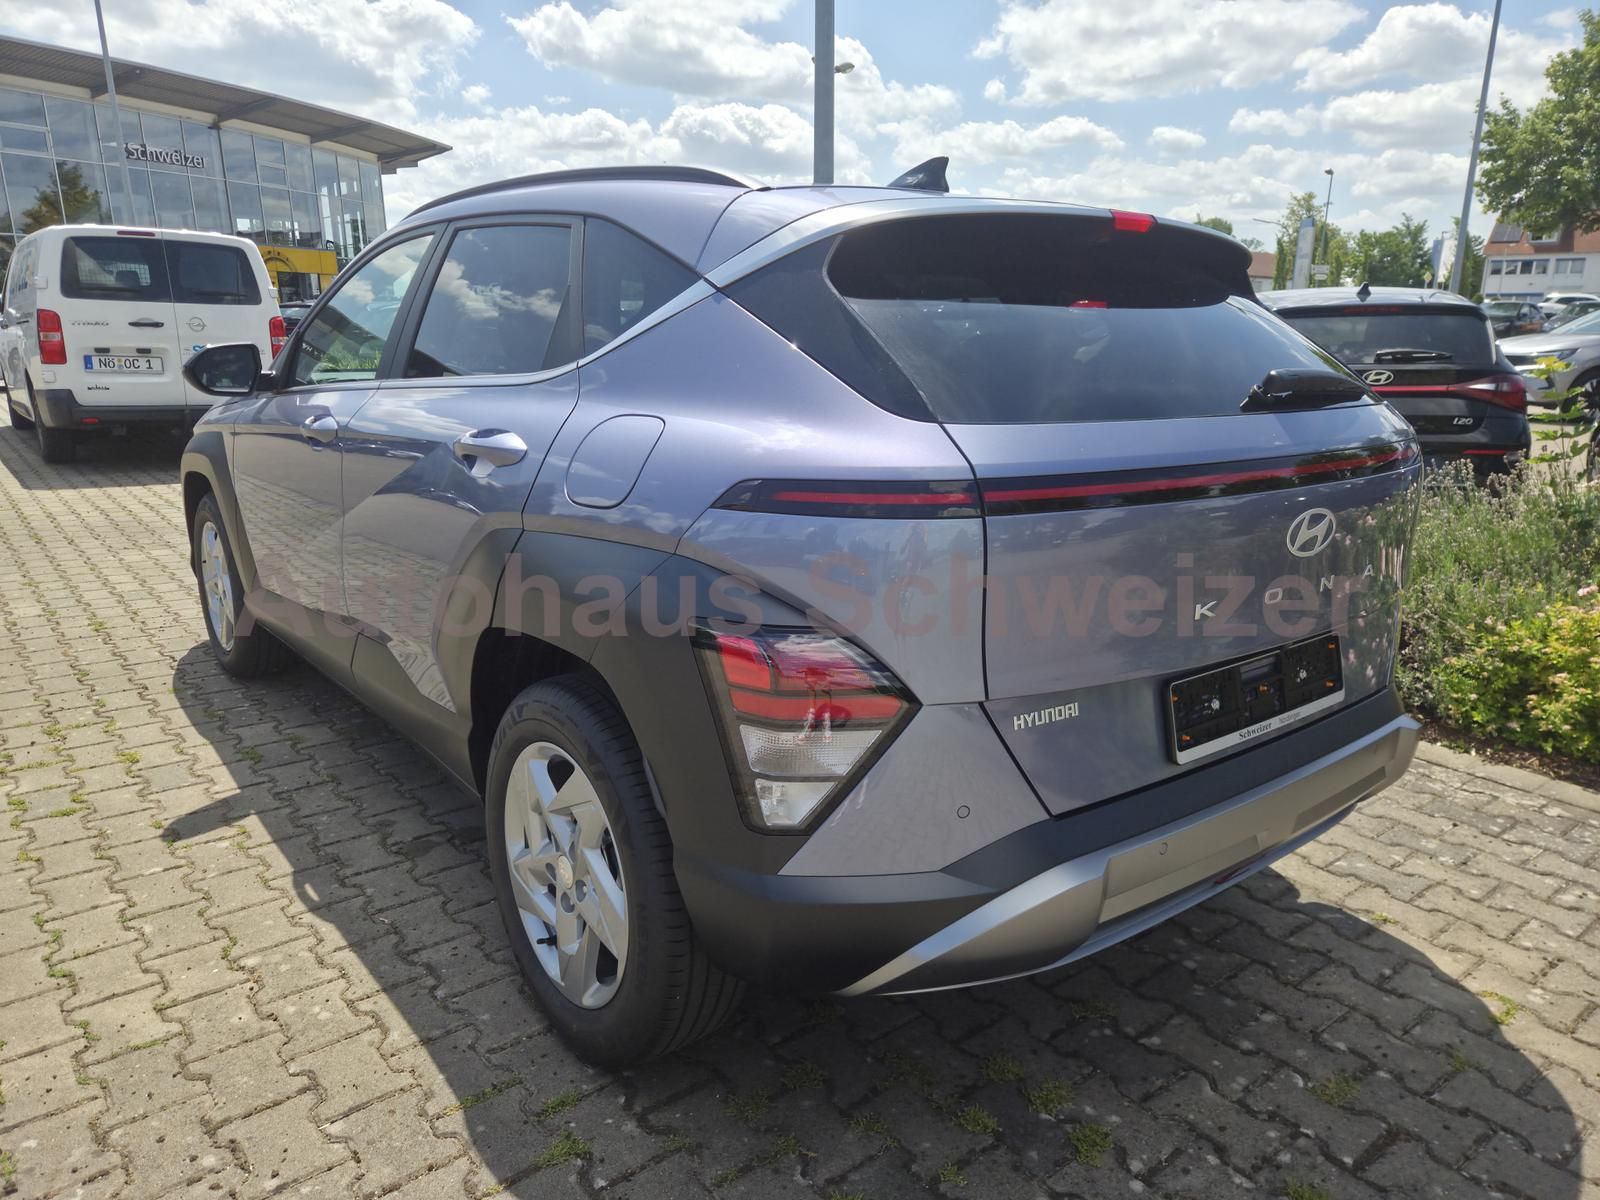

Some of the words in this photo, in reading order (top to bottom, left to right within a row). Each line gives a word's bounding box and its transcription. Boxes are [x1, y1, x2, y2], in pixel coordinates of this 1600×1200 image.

[126, 143, 208, 168] Schweizer
[124, 358, 140, 369] OC
[146, 359, 153, 369] 1
[1013, 702, 1079, 731] HYUNDAI
[1238, 722, 1273, 741] Schweizer
